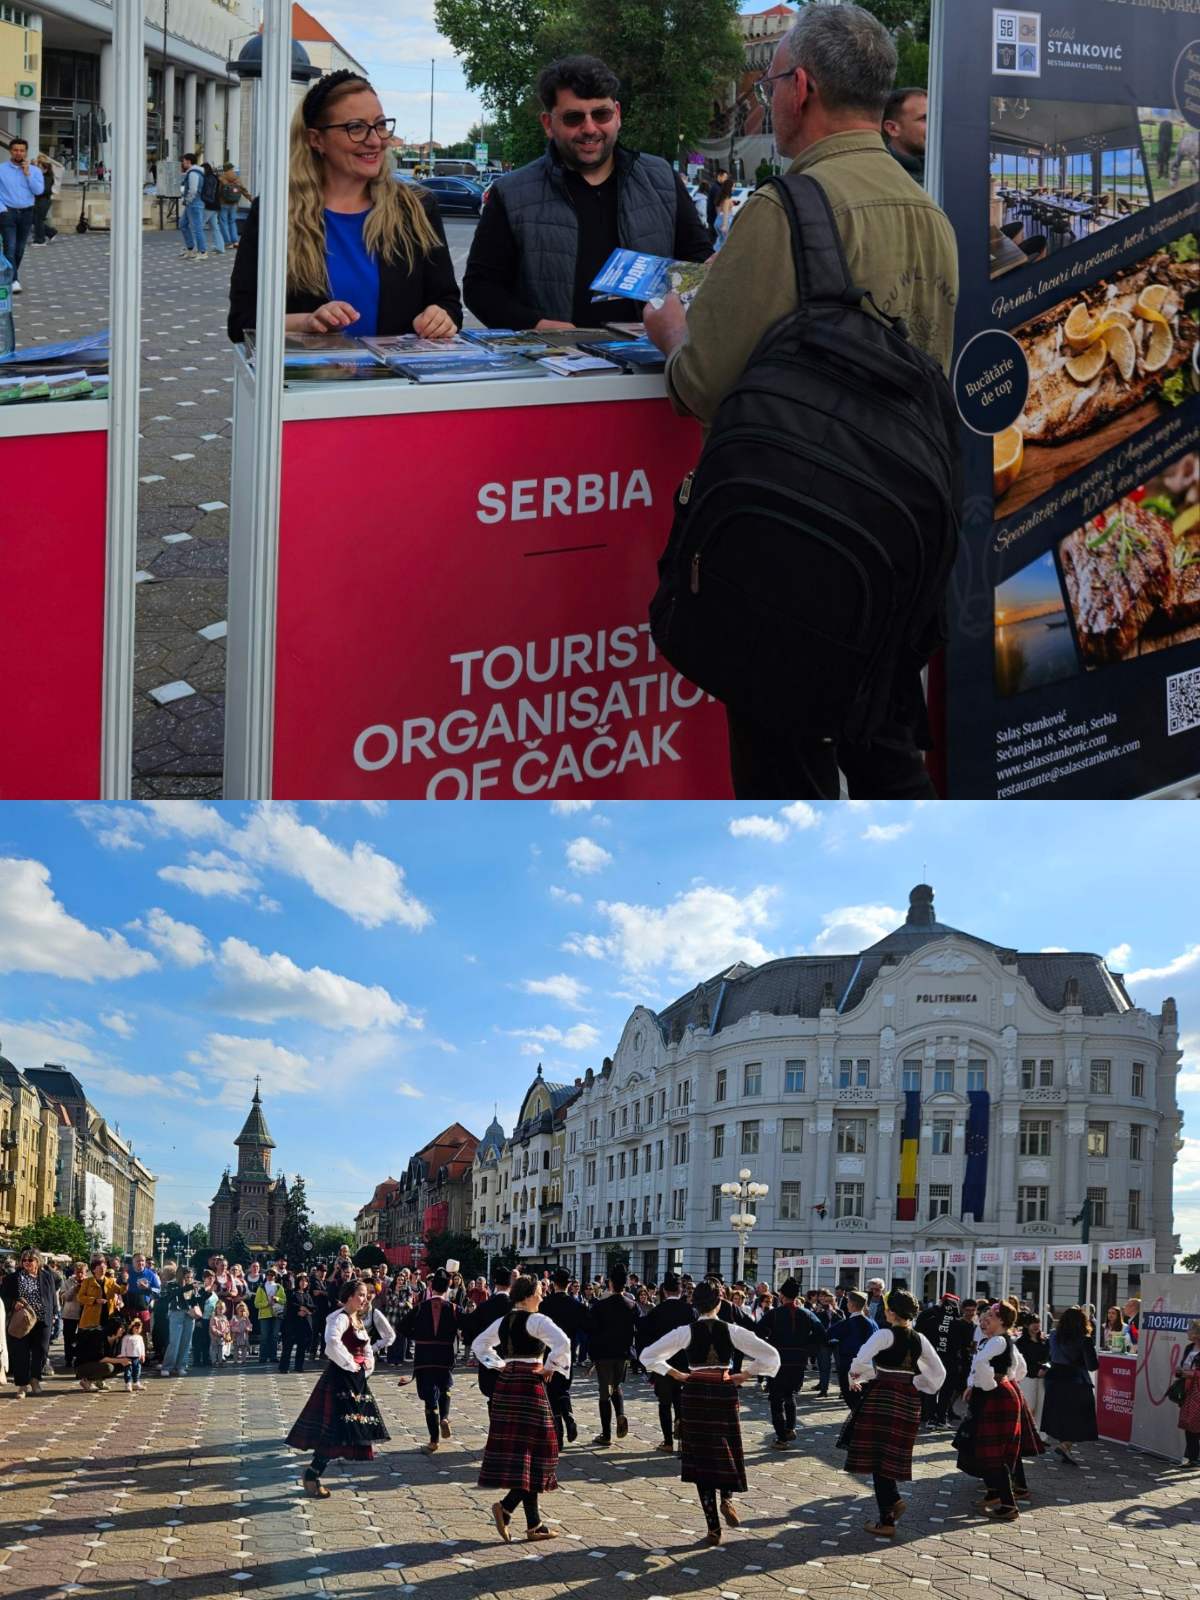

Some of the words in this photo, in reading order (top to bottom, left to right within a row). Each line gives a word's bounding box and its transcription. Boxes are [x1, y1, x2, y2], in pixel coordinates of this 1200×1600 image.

[1047, 40, 1122, 59] STANKOVIĆ
[1047, 59, 1081, 69] RESTAURANT
[1086, 63, 1104, 71] HOTEL
[20, 84, 34, 97] D
[1038, 268, 1069, 295] lacuri
[964, 358, 1014, 397] Bucătărie
[981, 391, 995, 407] de
[995, 379, 1013, 397] top
[476, 469, 653, 524] SERBIA
[450, 622, 657, 696] TOURIST
[353, 672, 717, 772] ORGANISATIO
[1022, 709, 1067, 735] Stanković
[996, 737, 1043, 762] Sečanjska
[1044, 732, 1057, 746] 18,
[1090, 711, 1118, 730] Serbia
[426, 758, 502, 800] OF
[512, 720, 682, 795] ČAČAK
[996, 733, 1108, 781] www.salasstankovic.com
[996, 739, 1141, 800] restaurante@salasstankovic.com
[916, 994, 978, 1003] POLITEHNICA
[980, 1253, 999, 1262] SERBIA
[1013, 1251, 1036, 1261] SERBIA
[1054, 1250, 1082, 1262] SERBIA
[1108, 1247, 1142, 1260] SERBIA
[936, 1336, 948, 1353] Los
